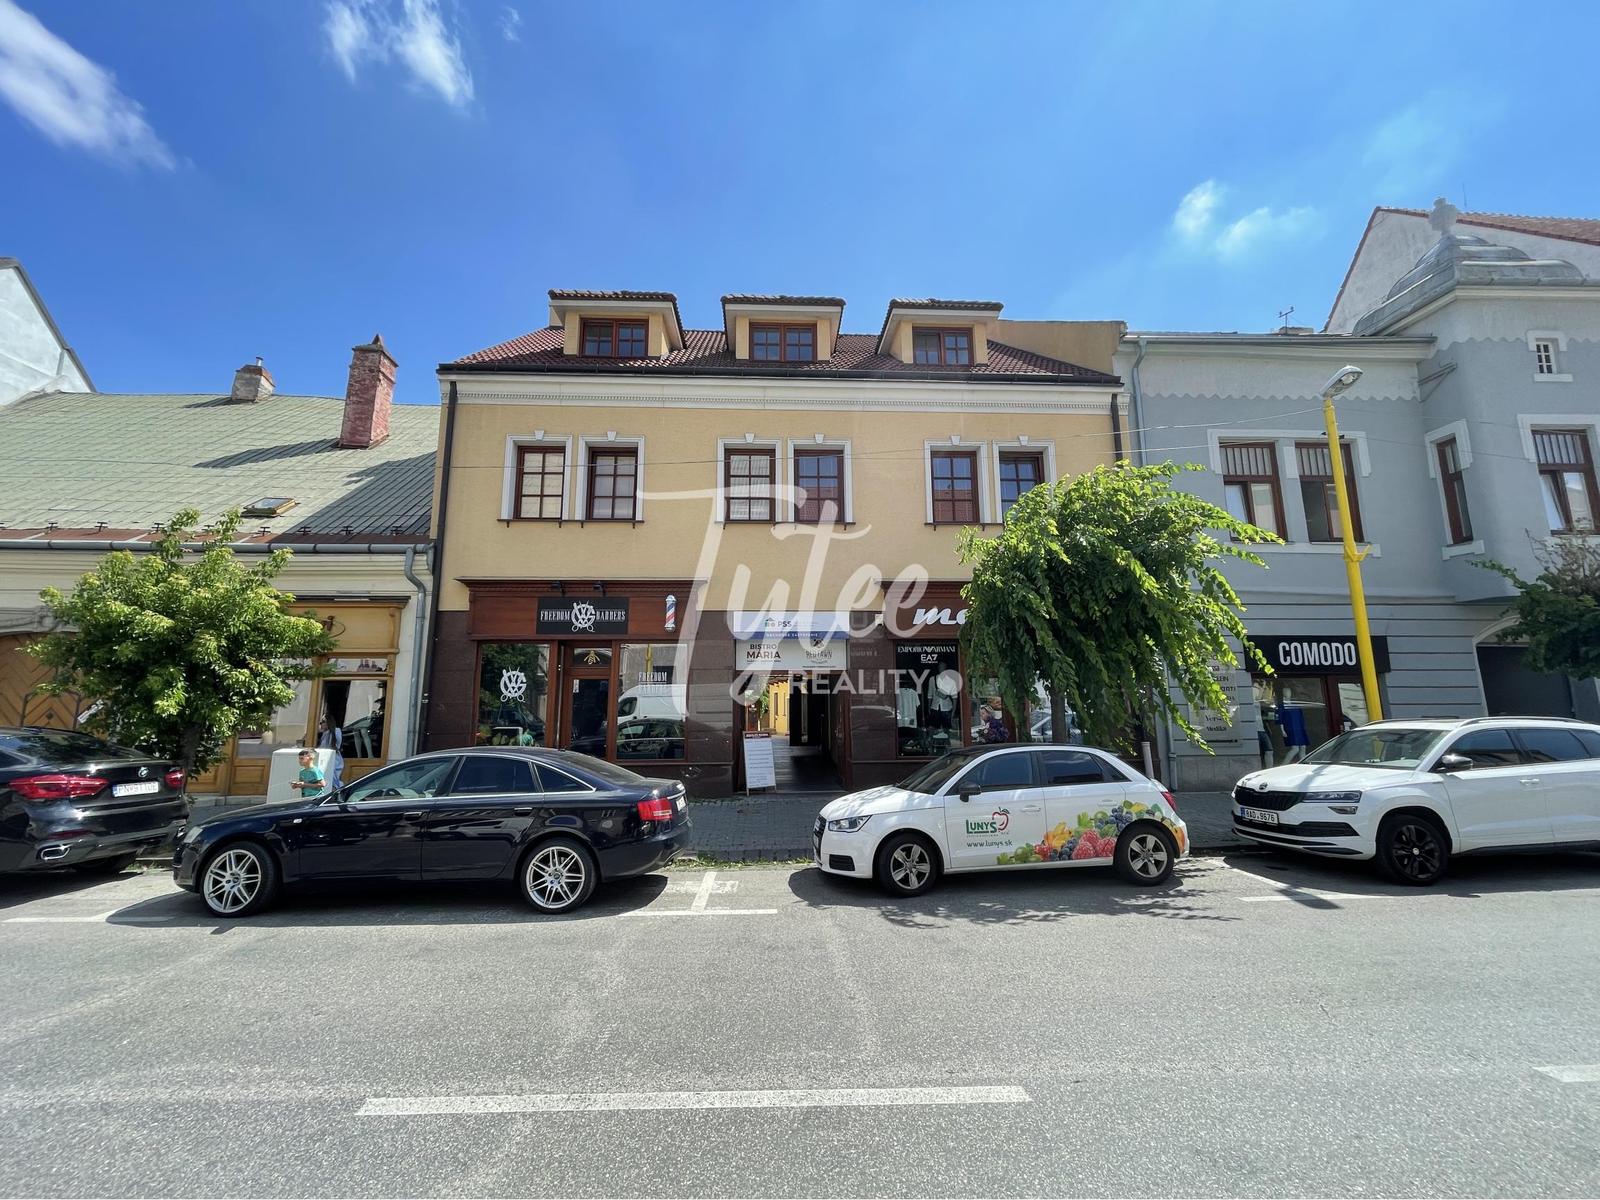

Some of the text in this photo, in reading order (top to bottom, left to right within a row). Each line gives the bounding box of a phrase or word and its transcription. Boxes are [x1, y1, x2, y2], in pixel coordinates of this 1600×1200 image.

[541, 611, 626, 620] FREEDOM BARBERS
[920, 653, 938, 662] EA7
[1278, 642, 1357, 666] COMODO
[966, 839, 1013, 848] www.lunys.sk
